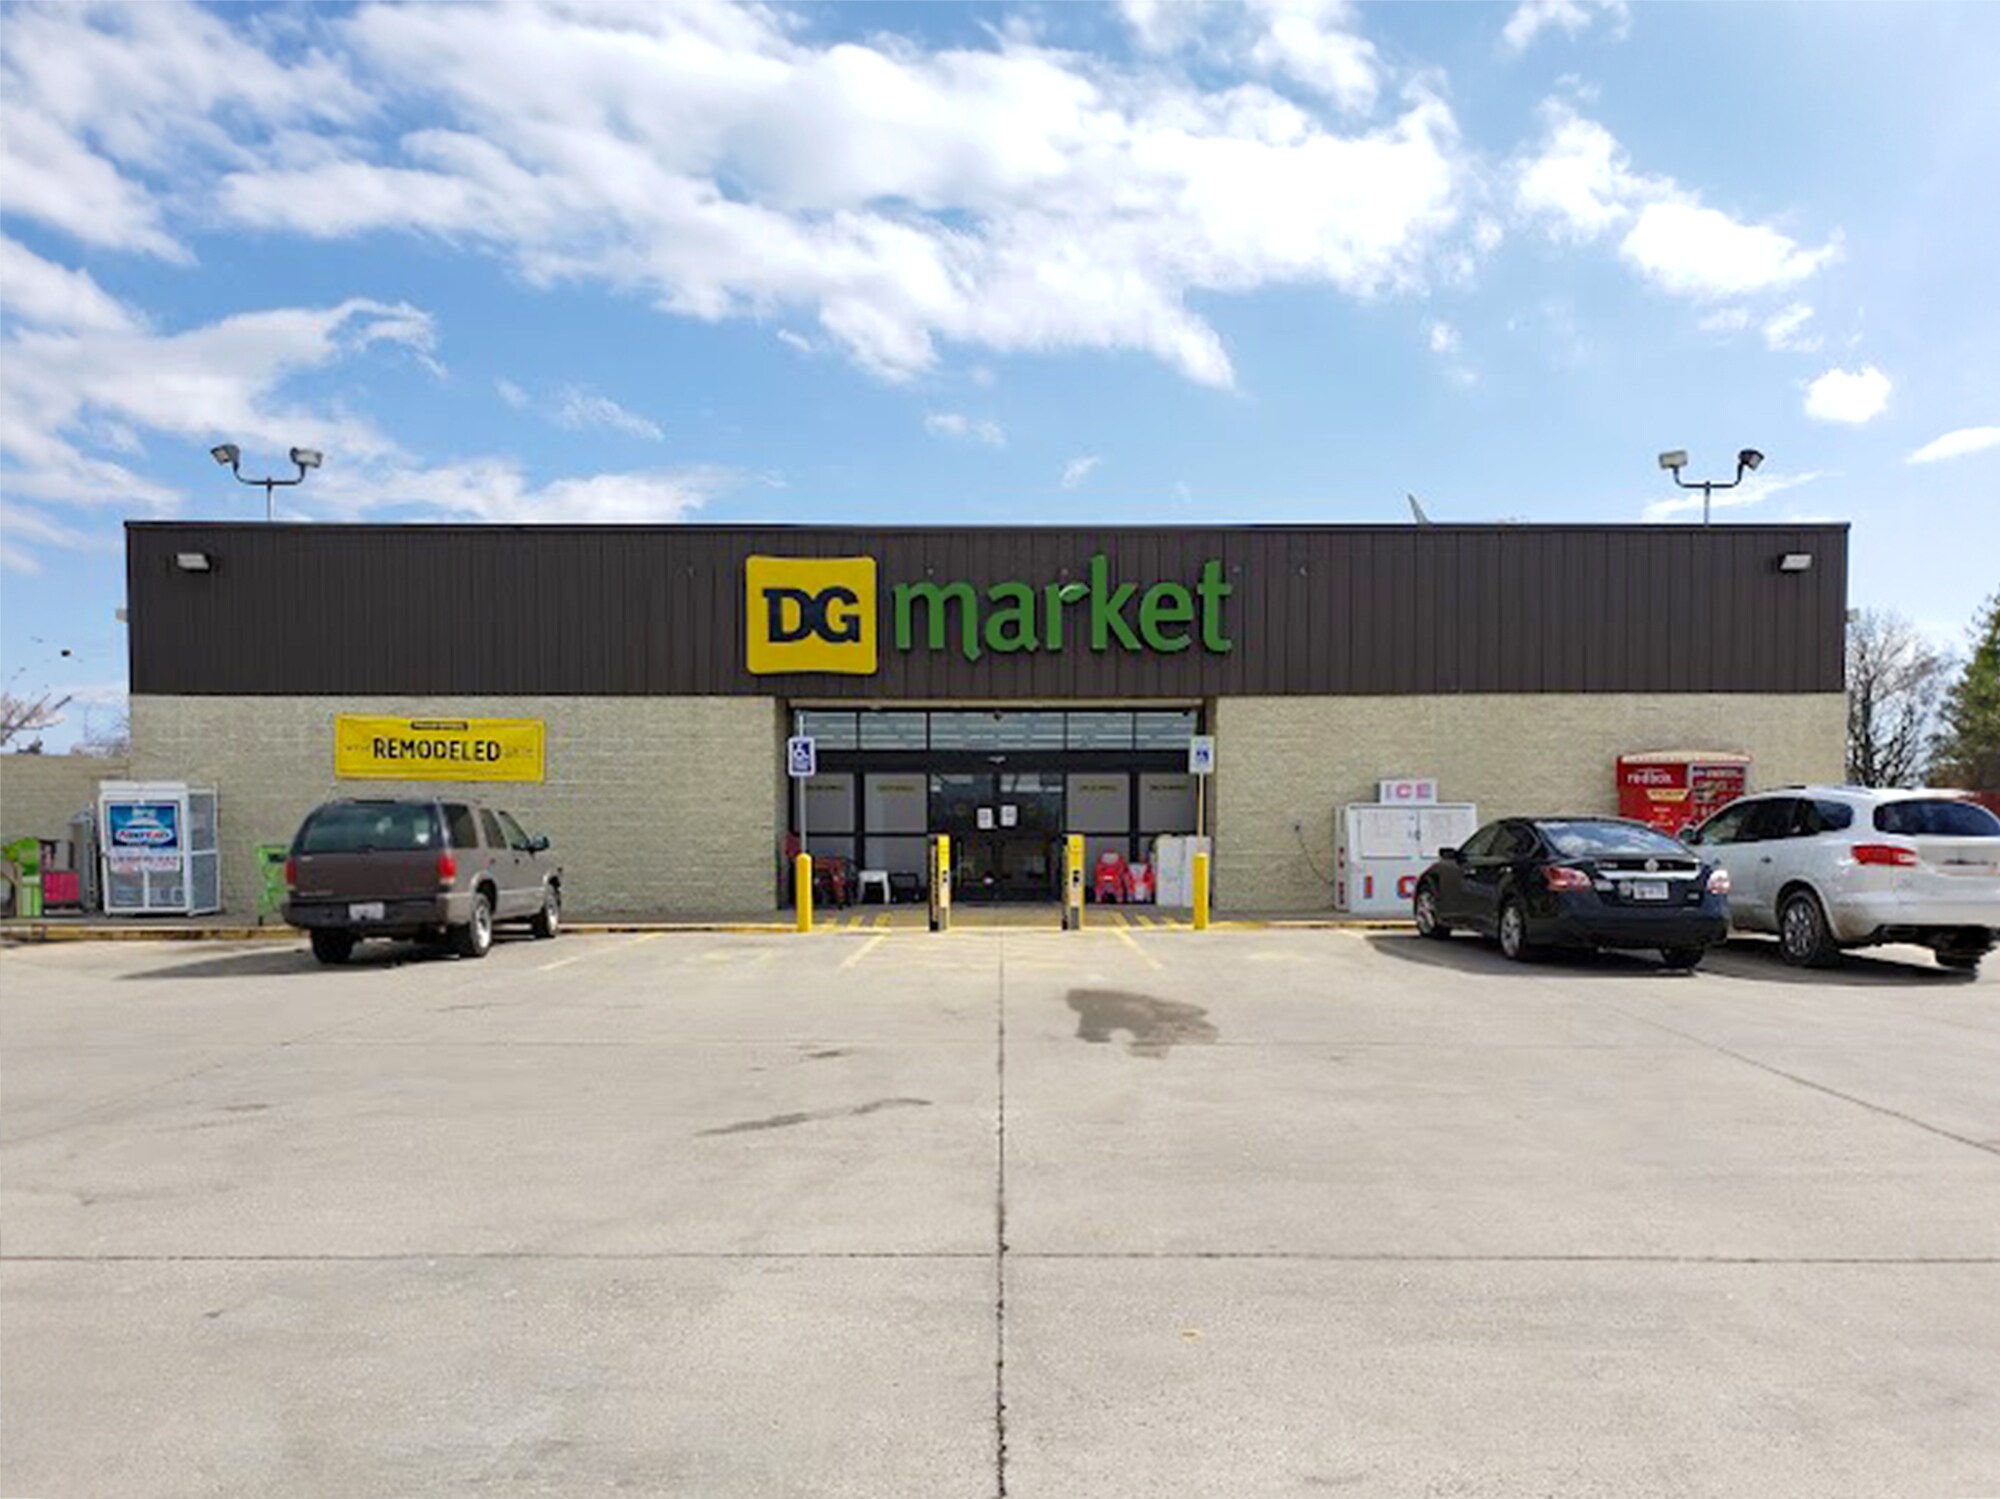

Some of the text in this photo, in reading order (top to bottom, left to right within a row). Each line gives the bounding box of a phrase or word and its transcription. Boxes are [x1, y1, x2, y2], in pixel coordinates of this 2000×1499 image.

[762, 554, 1233, 662] DG market
[373, 738, 500, 762] REMODELED
[1384, 783, 1431, 799] ICE
[1363, 874, 1418, 899] IC
